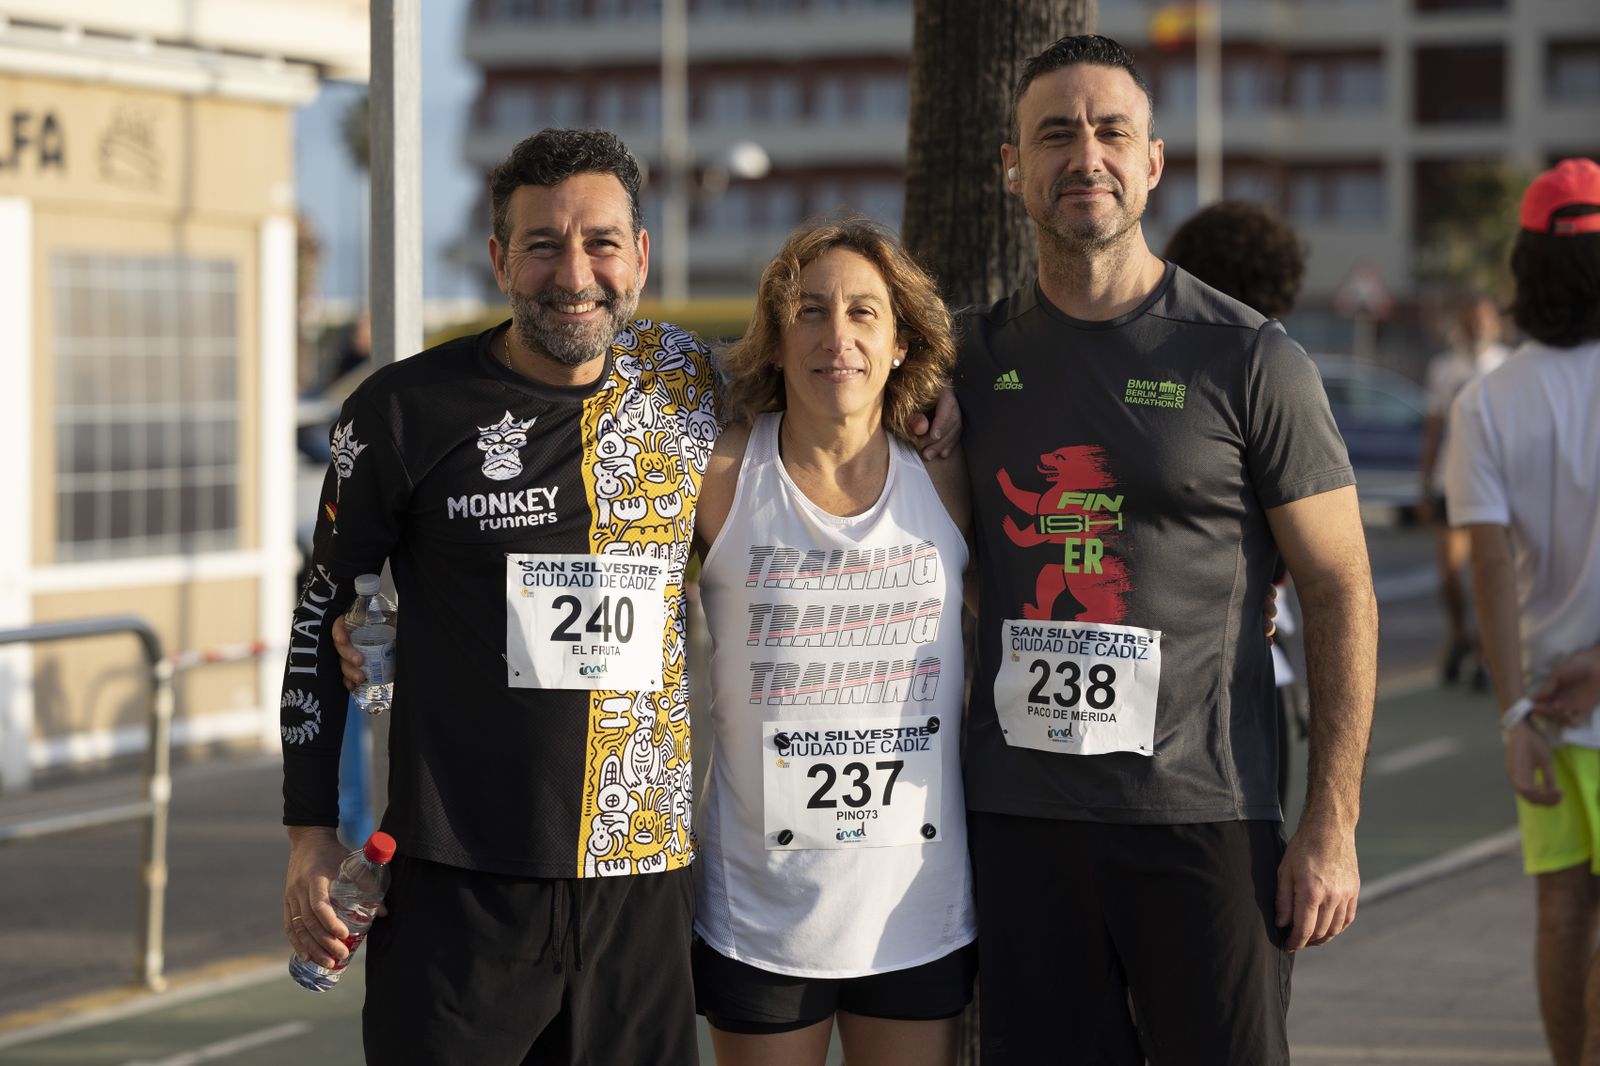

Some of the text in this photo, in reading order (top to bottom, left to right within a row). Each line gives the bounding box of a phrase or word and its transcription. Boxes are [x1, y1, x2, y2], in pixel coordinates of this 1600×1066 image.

[993, 381, 1024, 391] adidas
[1125, 388, 1157, 399] BERLIN
[1127, 379, 1157, 390] BMW
[1124, 396, 1175, 408] MARATHON
[1174, 384, 1187, 409] 2020
[447, 485, 560, 520] MONKEY
[1056, 491, 1124, 512] FIN
[479, 511, 559, 531] runners
[1040, 512, 1123, 534] ISH
[745, 539, 938, 591] TRAINING
[1064, 537, 1104, 575] ER
[522, 561, 659, 576] SAN SILVESTRE
[522, 573, 594, 588] CIUDAD
[599, 574, 617, 589] DE
[550, 594, 635, 644] 240
[747, 597, 942, 647] TRAINING
[1010, 625, 1149, 647] SAN SILVESTRE
[1011, 637, 1063, 653] CIUDAD
[1067, 641, 1090, 655] DE
[572, 645, 621, 656] EL FRUTA
[749, 656, 942, 706] TRAINING
[1027, 658, 1117, 710] 238
[1027, 706, 1117, 723] PACO DE MÉRIDA
[824, 727, 931, 741] SILVESTRE
[853, 740, 876, 755] DE
[806, 760, 904, 809] 237
[836, 810, 878, 821] PINO73
